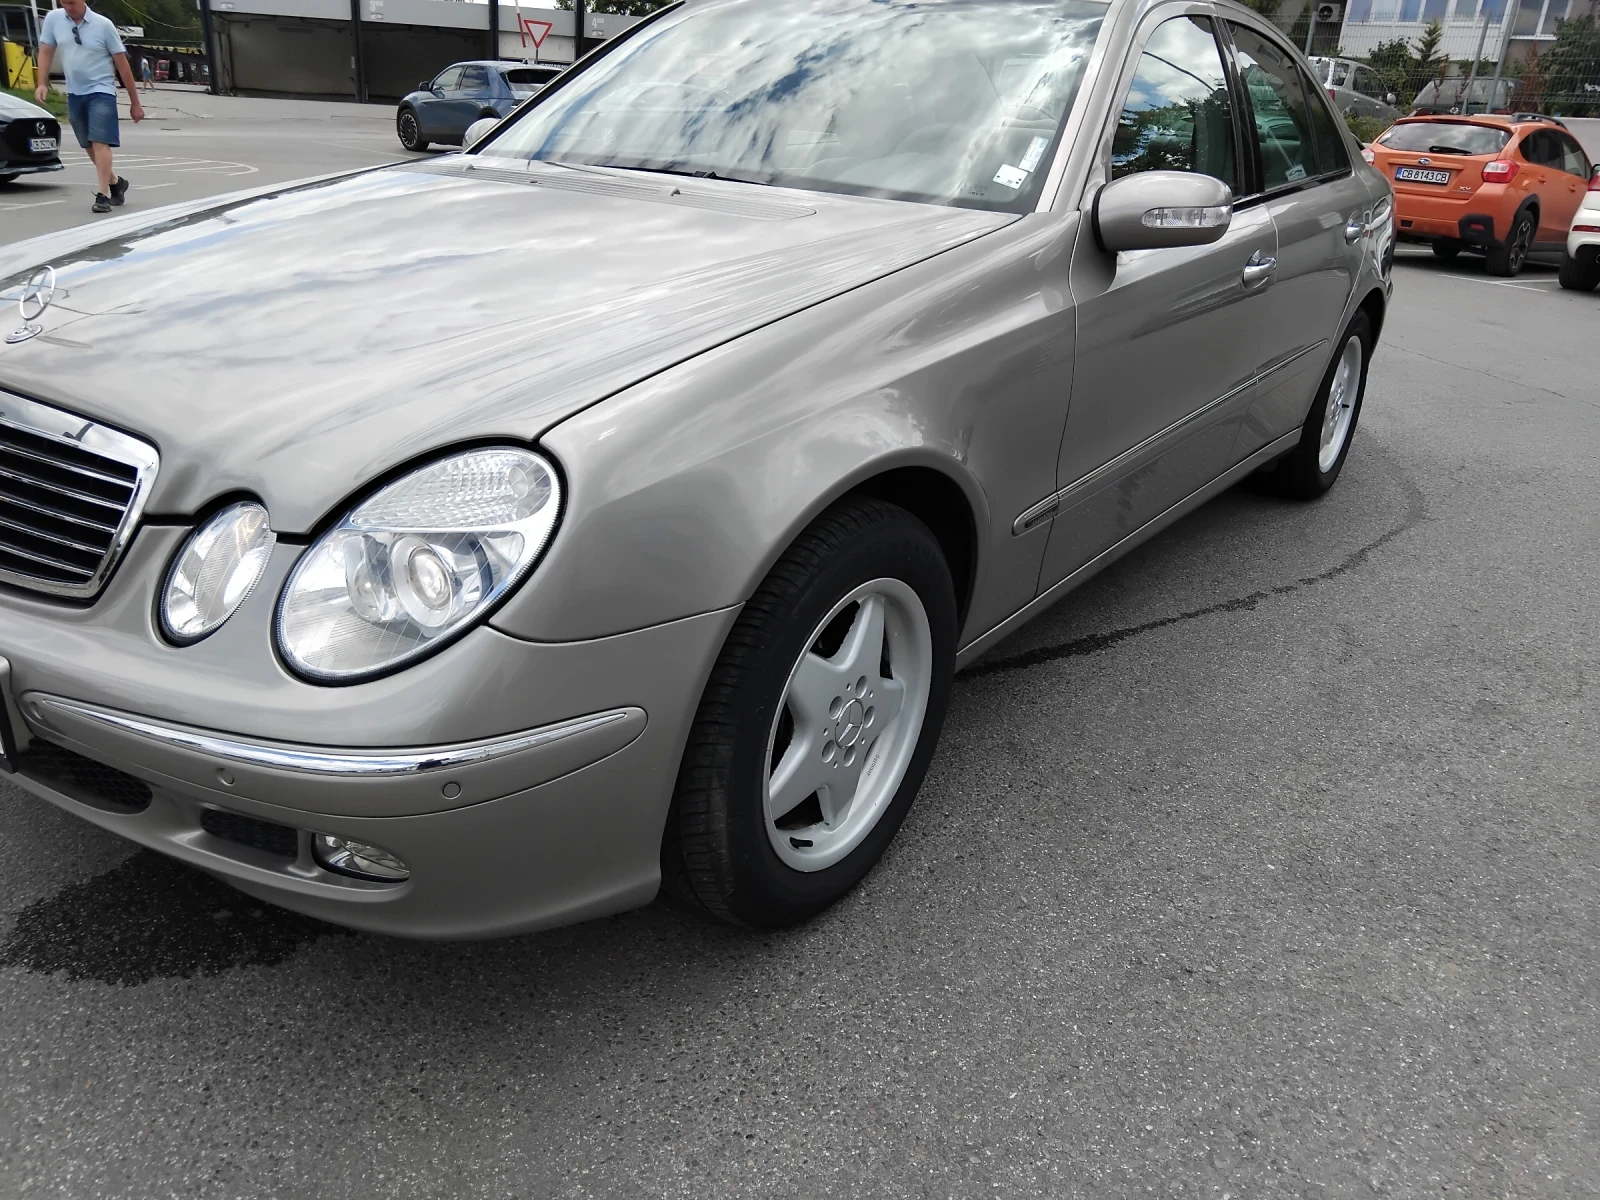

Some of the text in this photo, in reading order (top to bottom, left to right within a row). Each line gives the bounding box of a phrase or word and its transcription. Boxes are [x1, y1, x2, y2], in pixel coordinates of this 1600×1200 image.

[370, 0, 376, 12] 3
[592, 17, 597, 28] 4
[1401, 169, 1447, 182] CB 8143 CB
